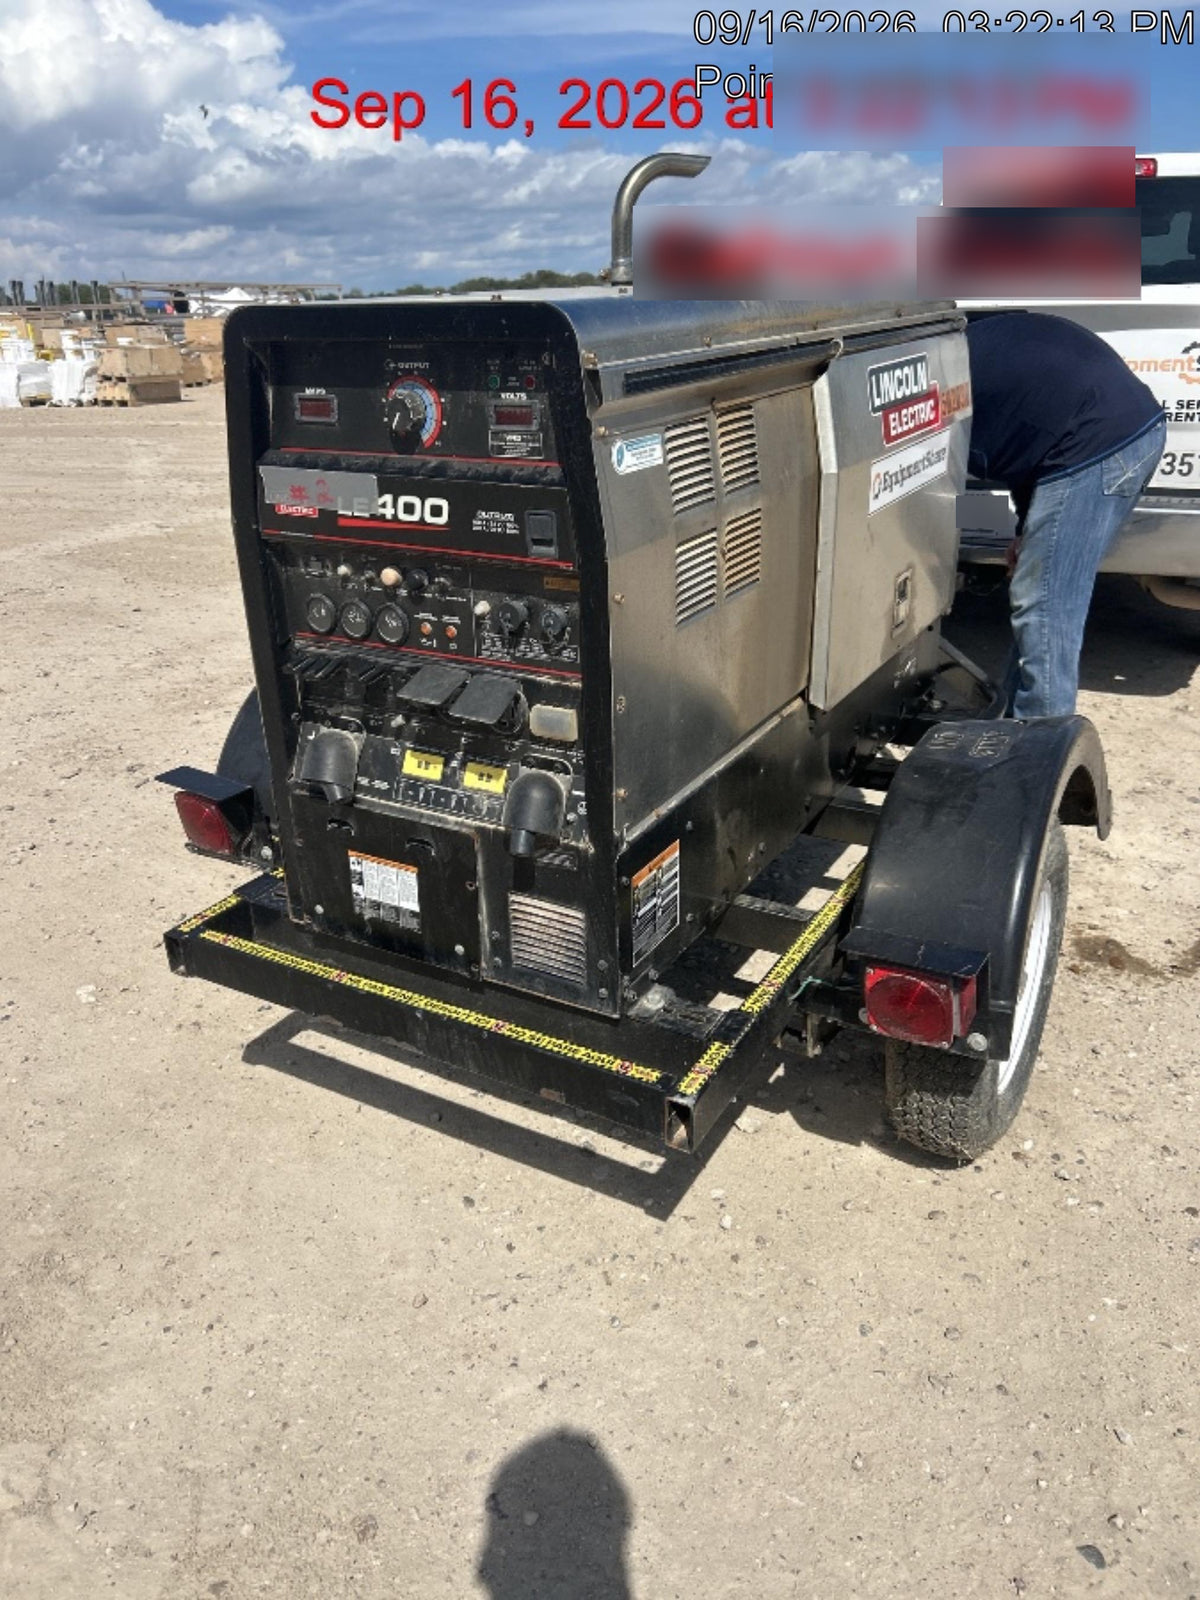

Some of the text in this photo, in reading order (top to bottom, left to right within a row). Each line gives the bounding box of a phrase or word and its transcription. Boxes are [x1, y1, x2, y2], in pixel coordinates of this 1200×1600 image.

[870, 360, 929, 407] LINCOLN
[500, 392, 528, 401] VOLTS
[1161, 400, 1171, 410] L
[887, 399, 936, 437] ELECTRIC
[1160, 452, 1200, 477] 35
